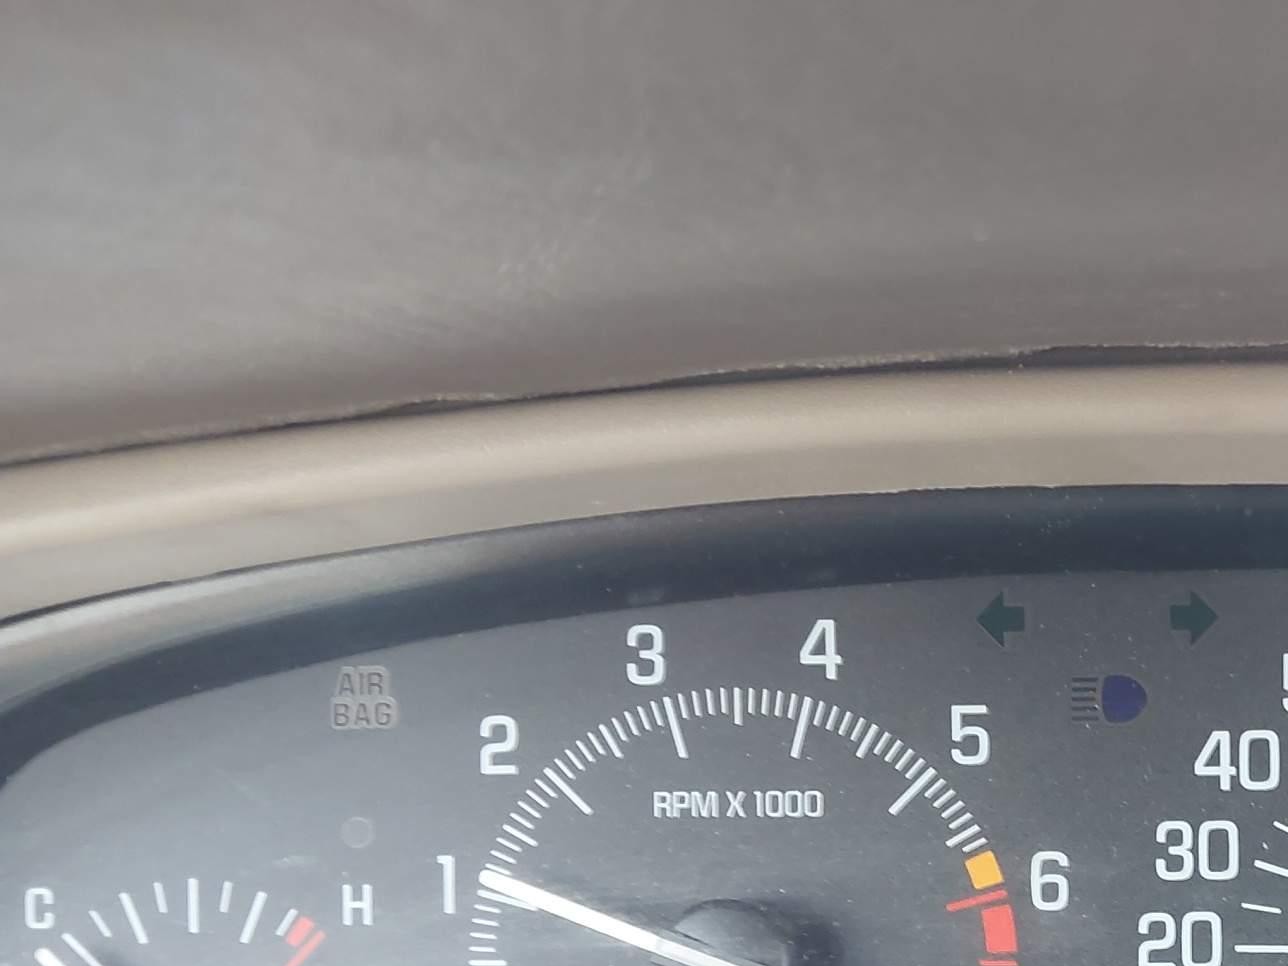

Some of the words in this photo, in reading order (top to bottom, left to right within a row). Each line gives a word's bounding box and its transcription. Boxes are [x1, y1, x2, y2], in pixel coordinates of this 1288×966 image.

[626, 624, 665, 686] 3
[799, 619, 843, 680] 4
[334, 701, 391, 727] BAG
[339, 671, 385, 696] AIR
[479, 714, 519, 775] 2
[950, 704, 990, 765] 5
[1194, 729, 1280, 791] 40
[653, 791, 719, 818] RPM
[725, 790, 747, 818] X
[753, 790, 824, 818] 1000
[1030, 850, 1070, 912] 6
[1155, 820, 1239, 881] 30
[24, 887, 55, 930] C
[342, 883, 373, 926] H
[436, 854, 456, 915] 1
